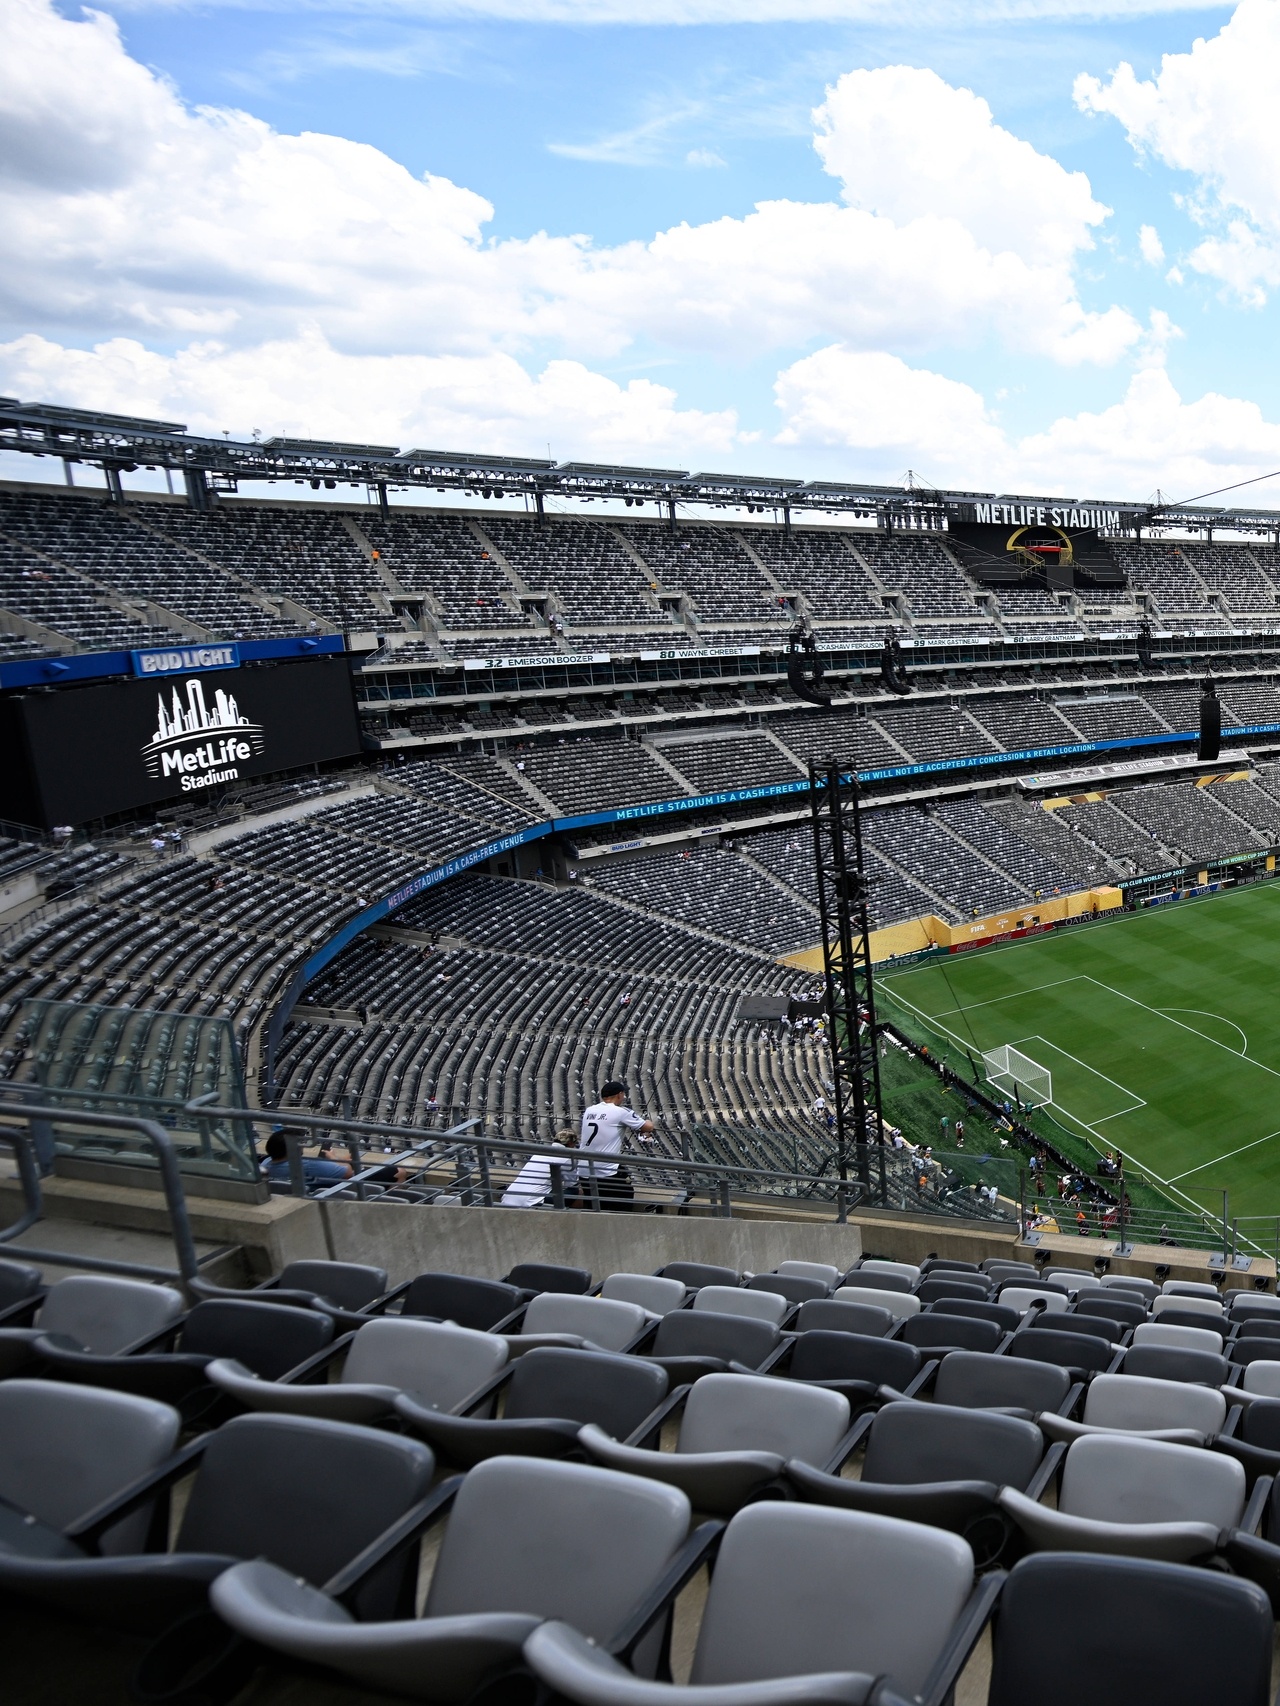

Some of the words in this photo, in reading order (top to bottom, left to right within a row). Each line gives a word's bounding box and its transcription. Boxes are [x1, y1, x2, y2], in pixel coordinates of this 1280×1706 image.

[976, 503, 1046, 526] METLIFE
[1052, 508, 1120, 529] STADIUM
[140, 651, 182, 672] BUD
[182, 648, 234, 668] LIGHT
[485, 660, 502, 668] 32
[508, 657, 555, 666] EMERSON
[556, 655, 594, 664] BOOZER
[161, 738, 251, 777] MetLife
[1140, 760, 1164, 768] STADIUM
[181, 768, 238, 791] Stadium
[616, 804, 664, 820] METLIFE
[668, 796, 713, 813] STADIUM
[717, 794, 726, 803] IS
[730, 793, 736, 801] A
[739, 782, 793, 800] CASH-FREE
[848, 774, 870, 784] CSH
[872, 770, 893, 780] WILL
[896, 767, 911, 776] NOT
[913, 765, 924, 773] BE
[926, 760, 966, 772] ACCEPTED
[968, 758, 977, 766] AT
[979, 752, 1024, 764] CONCESSION
[1034, 749, 1057, 757] RETAIL
[1060, 744, 1096, 754] LOCATIONS
[1230, 855, 1248, 863] WORLD
[388, 884, 414, 910] METLIFE
[414, 868, 445, 891] STADIUM
[446, 865, 454, 876] IS
[455, 862, 460, 871] A
[461, 842, 499, 868] CASH-FREE
[500, 833, 524, 850] VENUE
[1143, 874, 1161, 883] WORLD
[1157, 894, 1173, 904] VISA
[1196, 887, 1211, 895] VISA
[1065, 914, 1093, 926] QATAR
[1097, 904, 1130, 919] AIRWAYS
[970, 925, 986, 933] FIFA
[586, 1123, 598, 1146] 7
